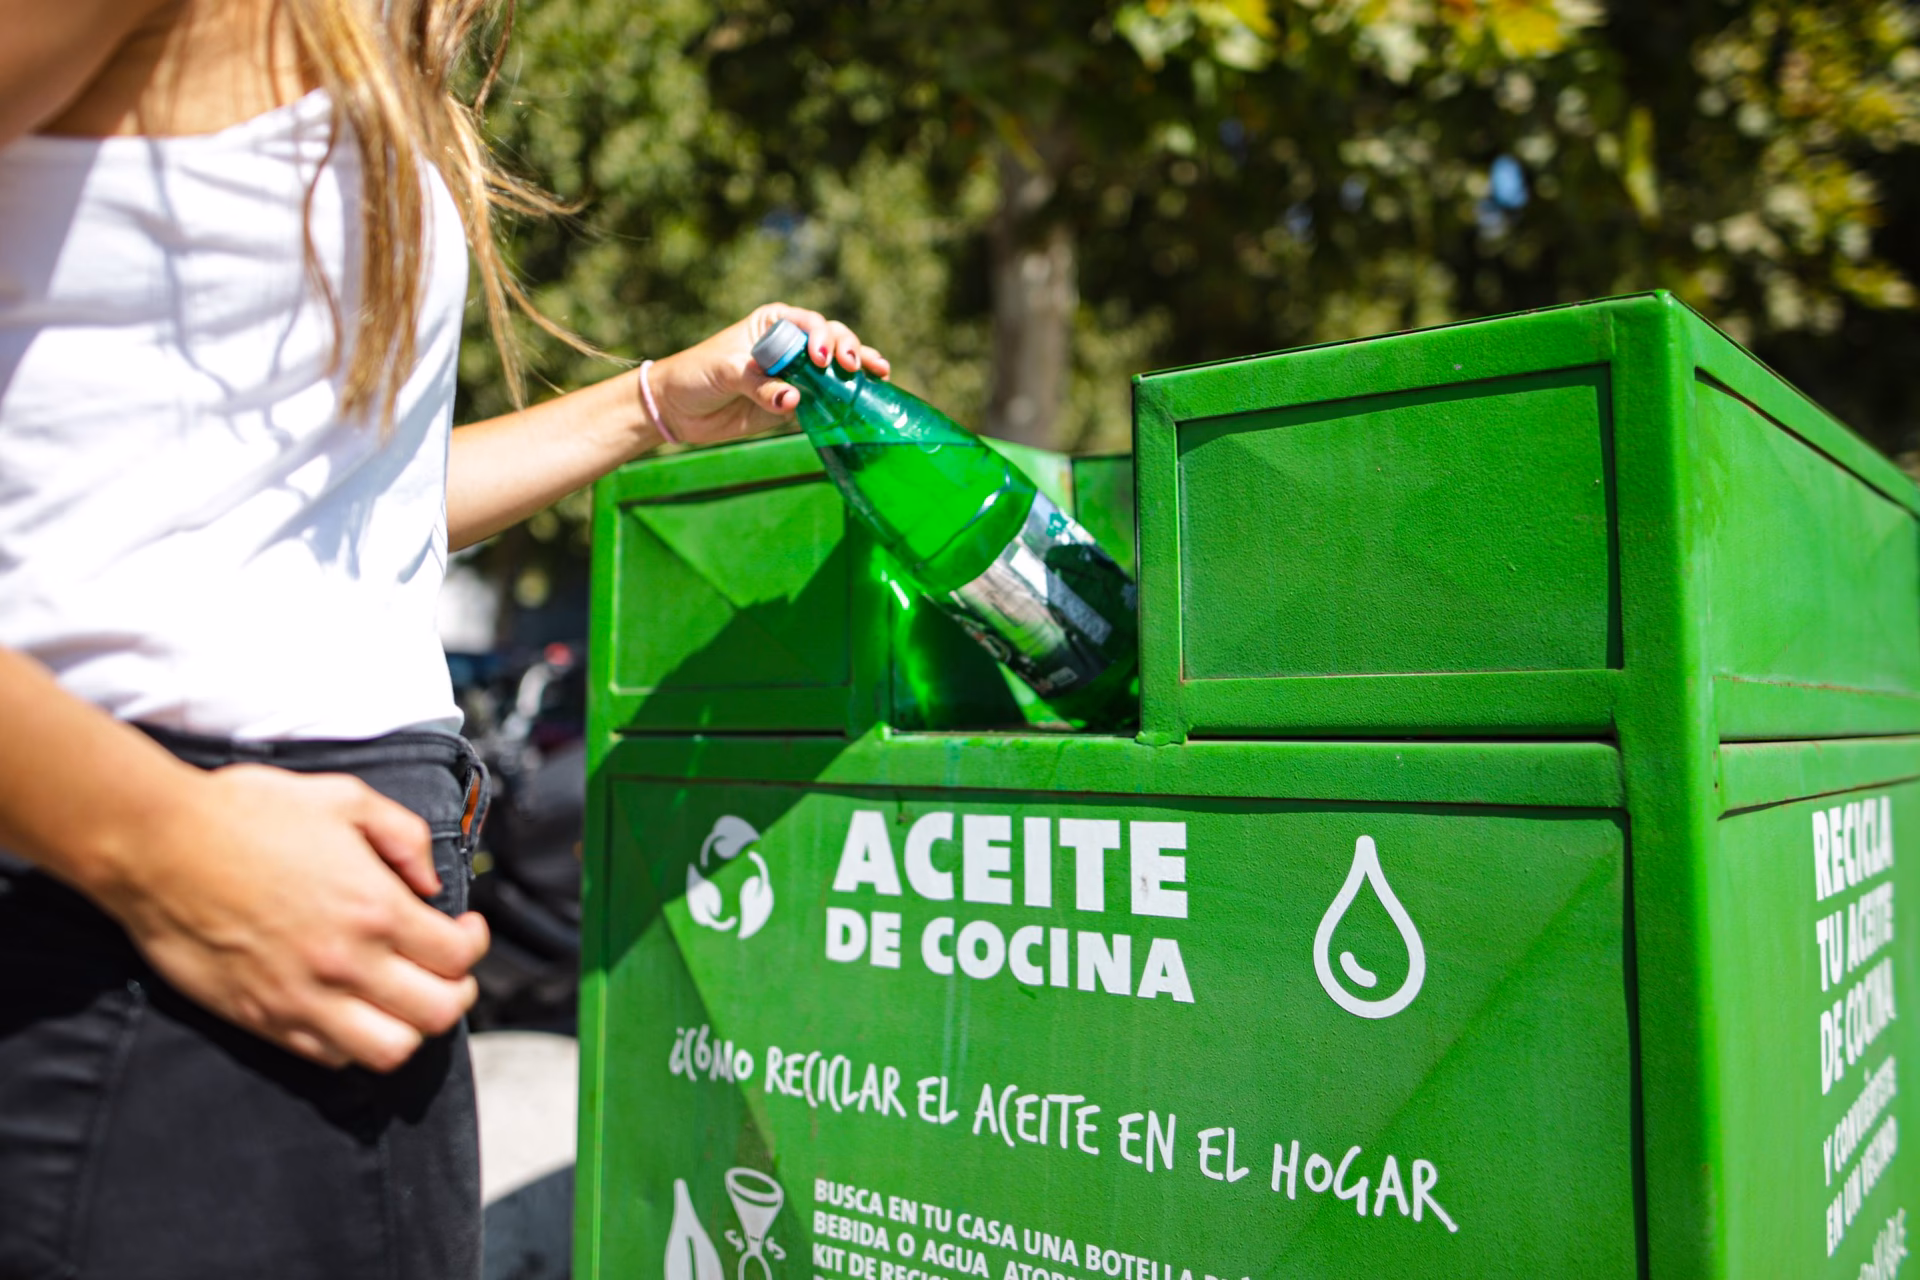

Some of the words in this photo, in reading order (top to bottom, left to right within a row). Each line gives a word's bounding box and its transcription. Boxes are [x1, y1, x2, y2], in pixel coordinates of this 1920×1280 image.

[833, 810, 1188, 919] ACEITE
[1812, 796, 1894, 902] RECICLA
[825, 906, 900, 969] DE
[920, 917, 1195, 1003] COCINA
[1816, 910, 1843, 992] TU
[1820, 1000, 1844, 1096] DE
[764, 1046, 907, 1118] RECICLAR
[917, 1075, 959, 1125] EL
[972, 1083, 1101, 1156] ACEITE
[1118, 1109, 1176, 1173] EN
[1197, 1126, 1249, 1183] EL
[1270, 1139, 1459, 1233] HOGAR
[812, 1242, 846, 1273] KIT
[848, 1252, 877, 1280] DE
[813, 1210, 891, 1252] BEBIDA
[897, 1232, 916, 1257] O
[922, 1239, 990, 1279] AGUA
[814, 1178, 885, 1217] BUSCA
[888, 1195, 918, 1225] EN
[922, 1203, 952, 1233] TU
[956, 1213, 1018, 1251] CASA
[1023, 1228, 1080, 1267] UNA
